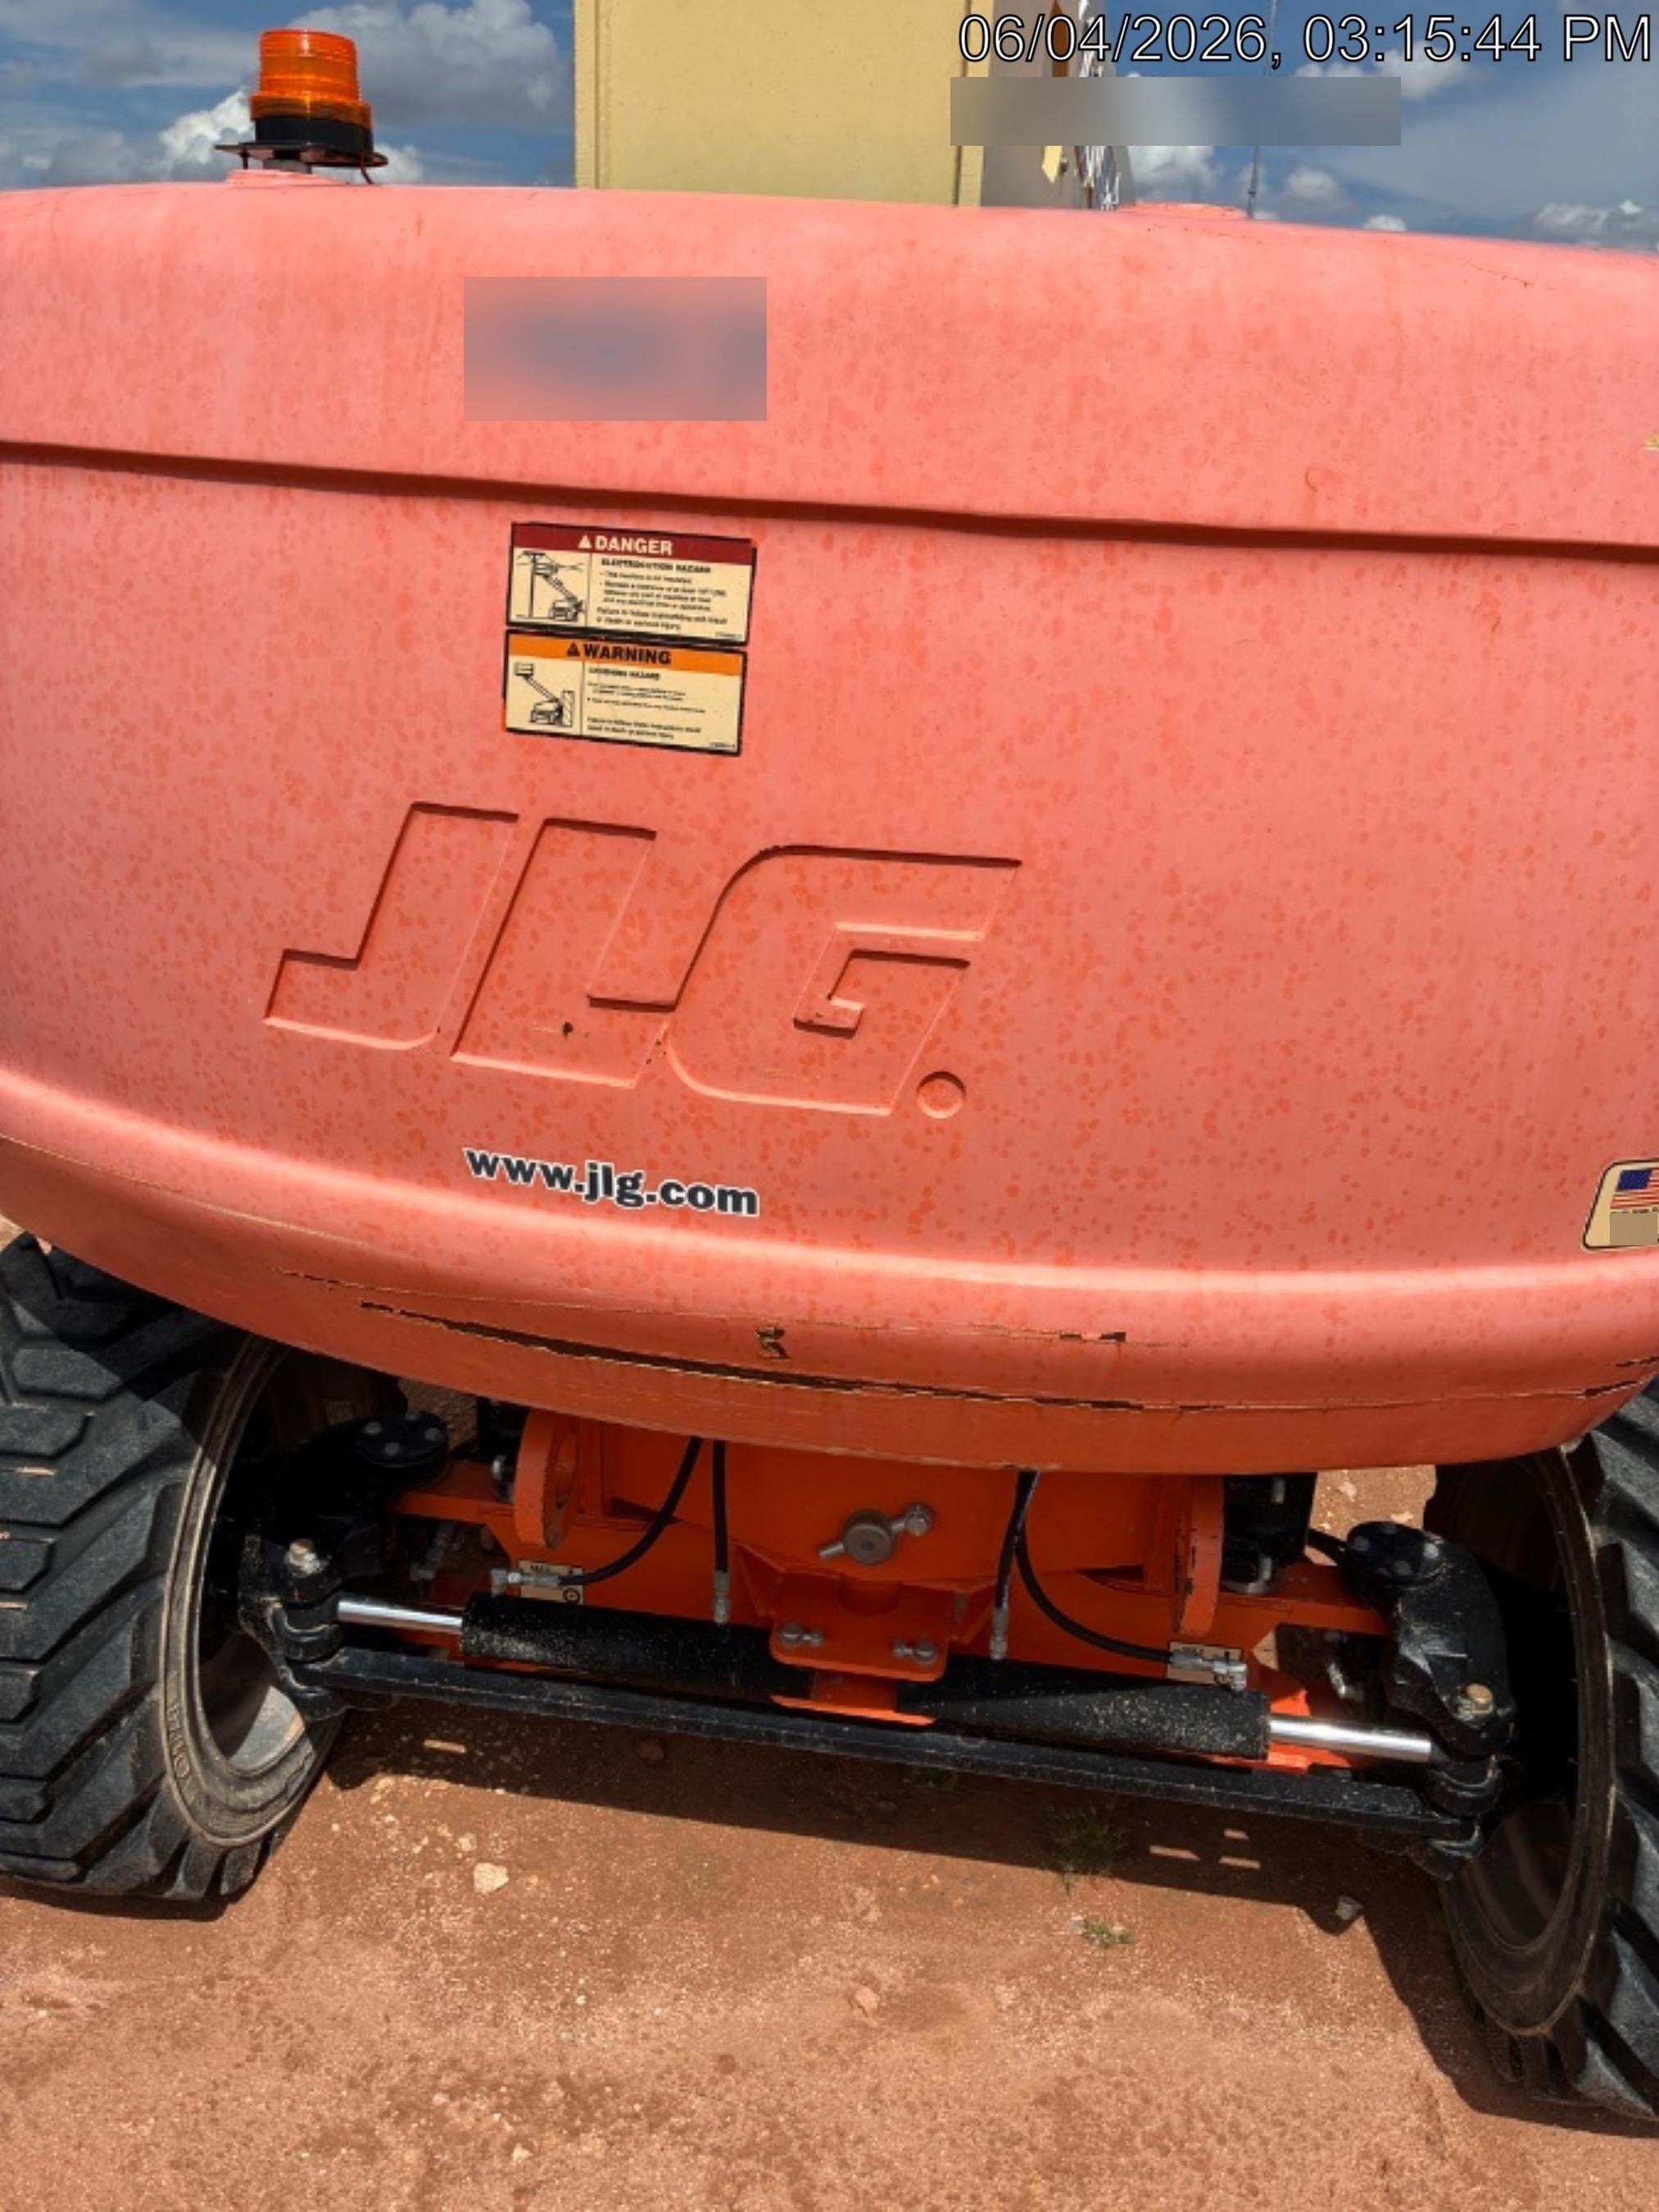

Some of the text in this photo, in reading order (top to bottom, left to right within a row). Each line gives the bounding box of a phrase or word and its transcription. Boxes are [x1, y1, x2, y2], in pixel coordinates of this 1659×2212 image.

[596, 536, 673, 555] DANGER
[584, 643, 672, 664] WARNING
[463, 1147, 760, 1217] www.jlg.com
